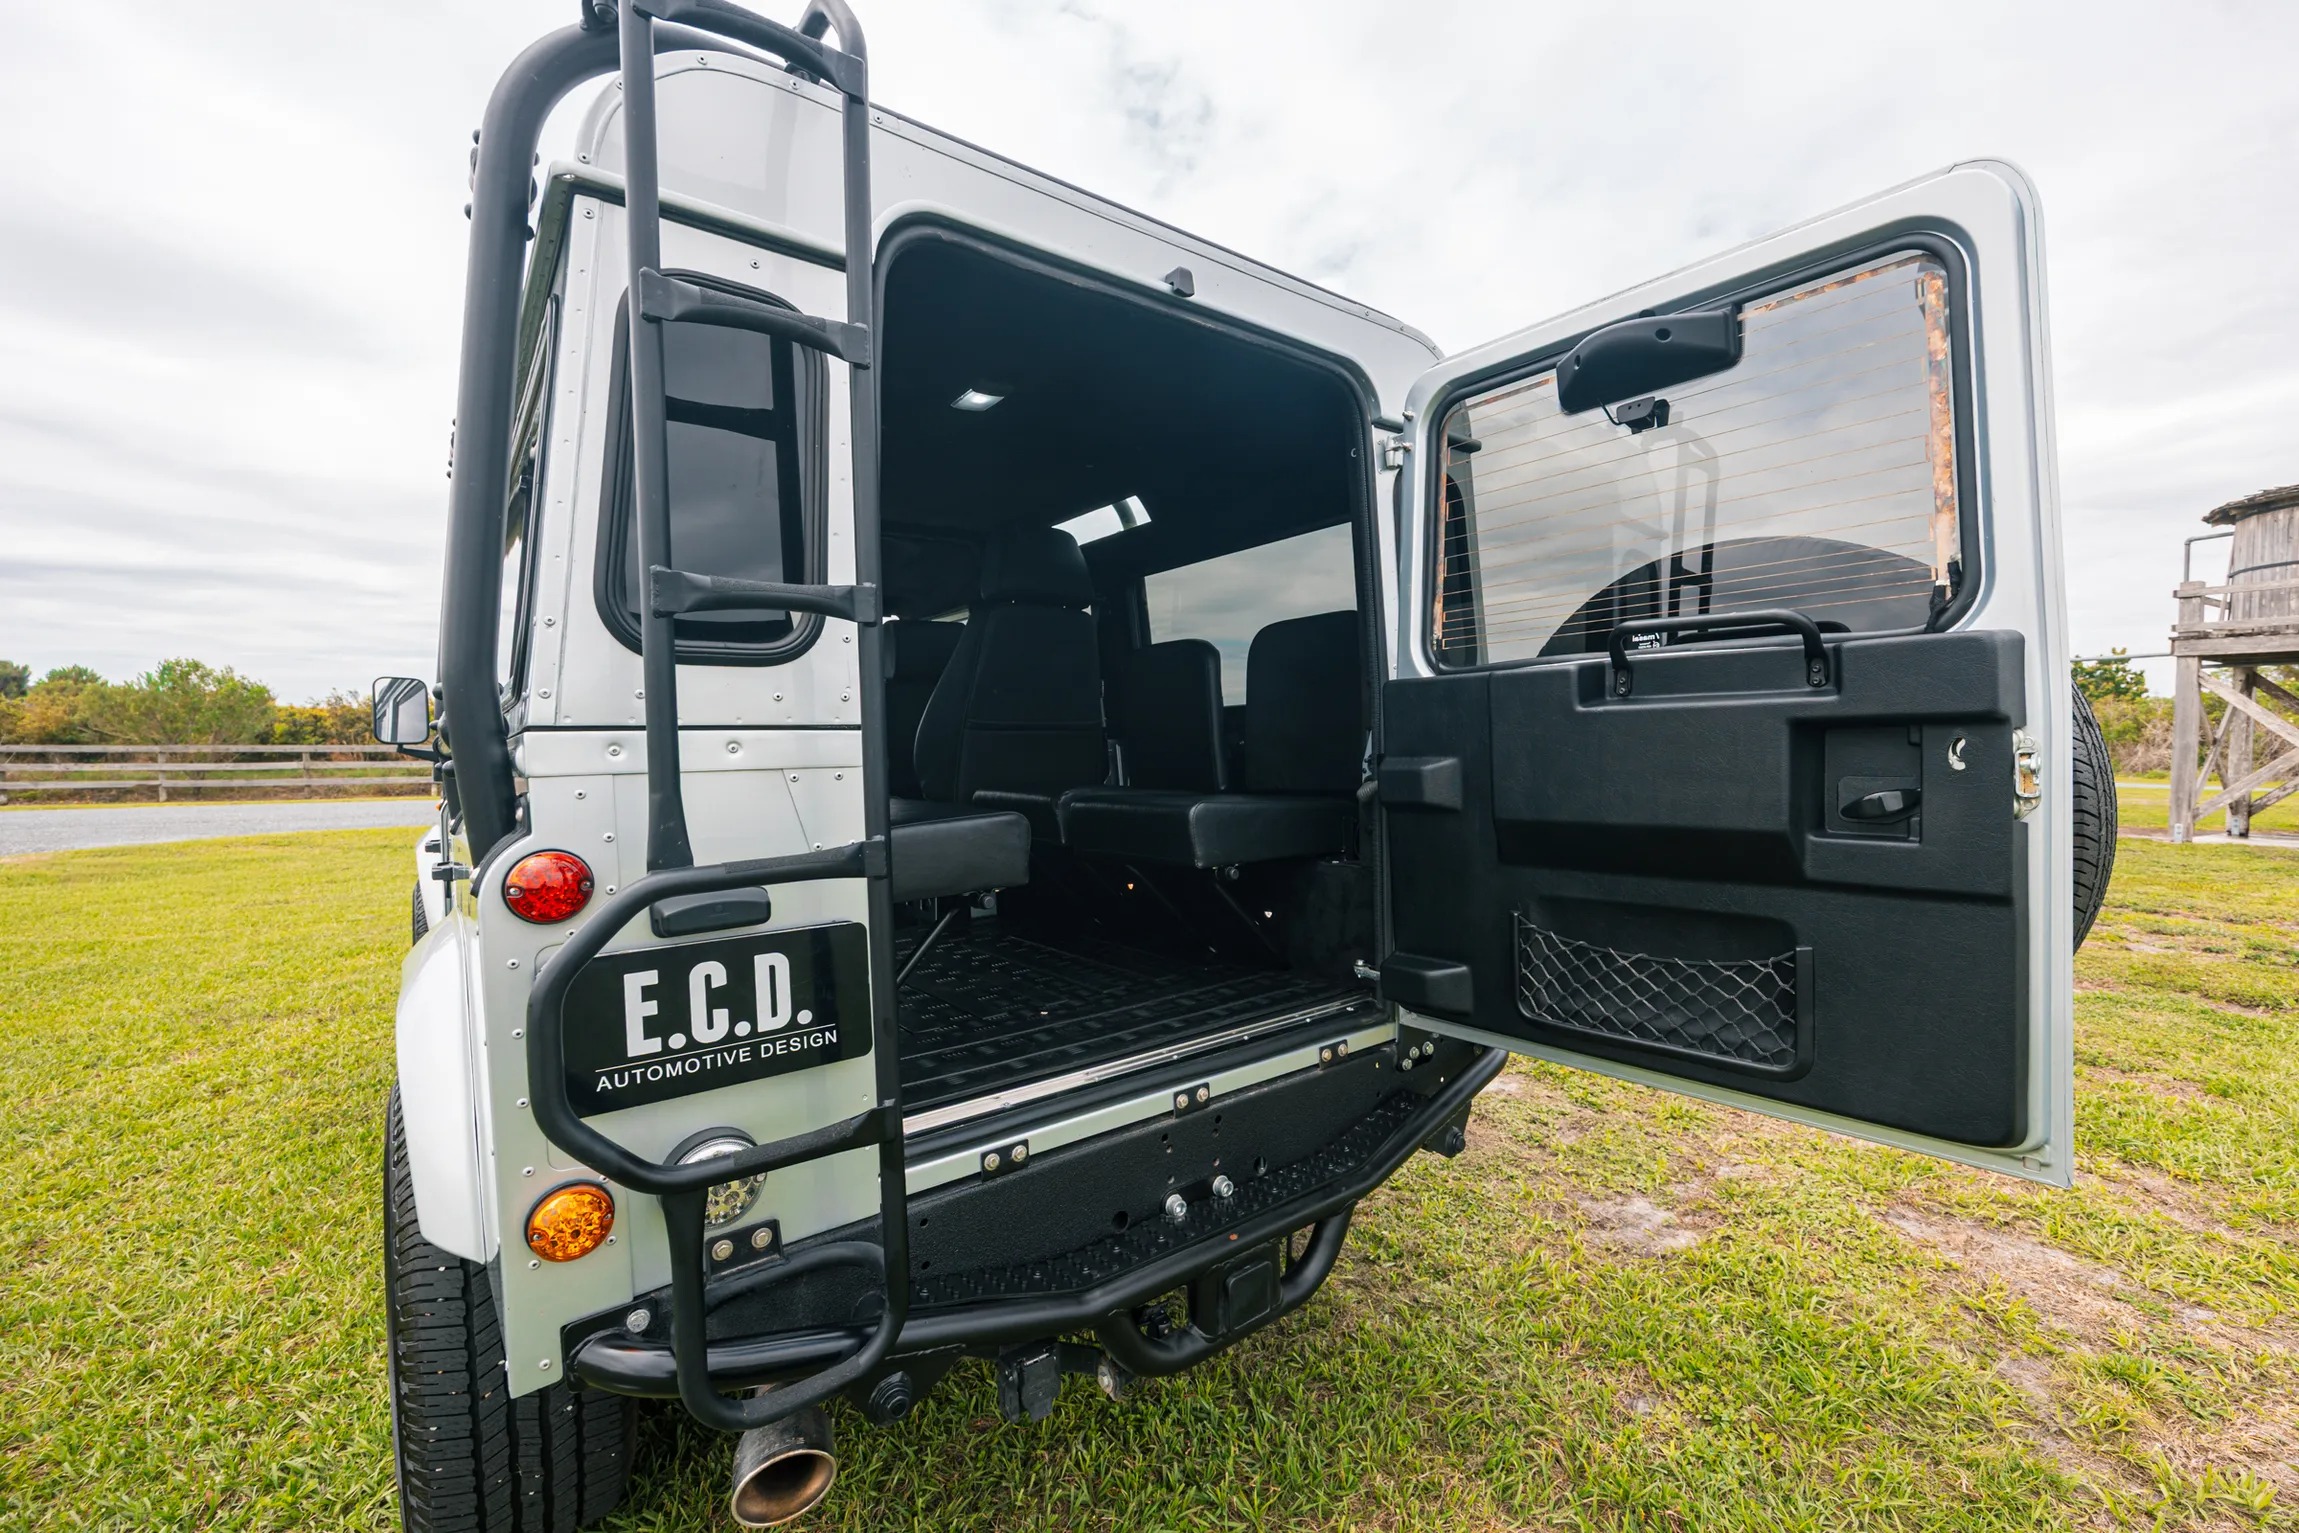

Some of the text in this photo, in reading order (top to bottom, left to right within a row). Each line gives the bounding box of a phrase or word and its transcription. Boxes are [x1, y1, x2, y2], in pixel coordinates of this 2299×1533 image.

[623, 952, 813, 1058] E.C.D.
[596, 1029, 838, 1092] AUTOMOTIVE DESIGN
